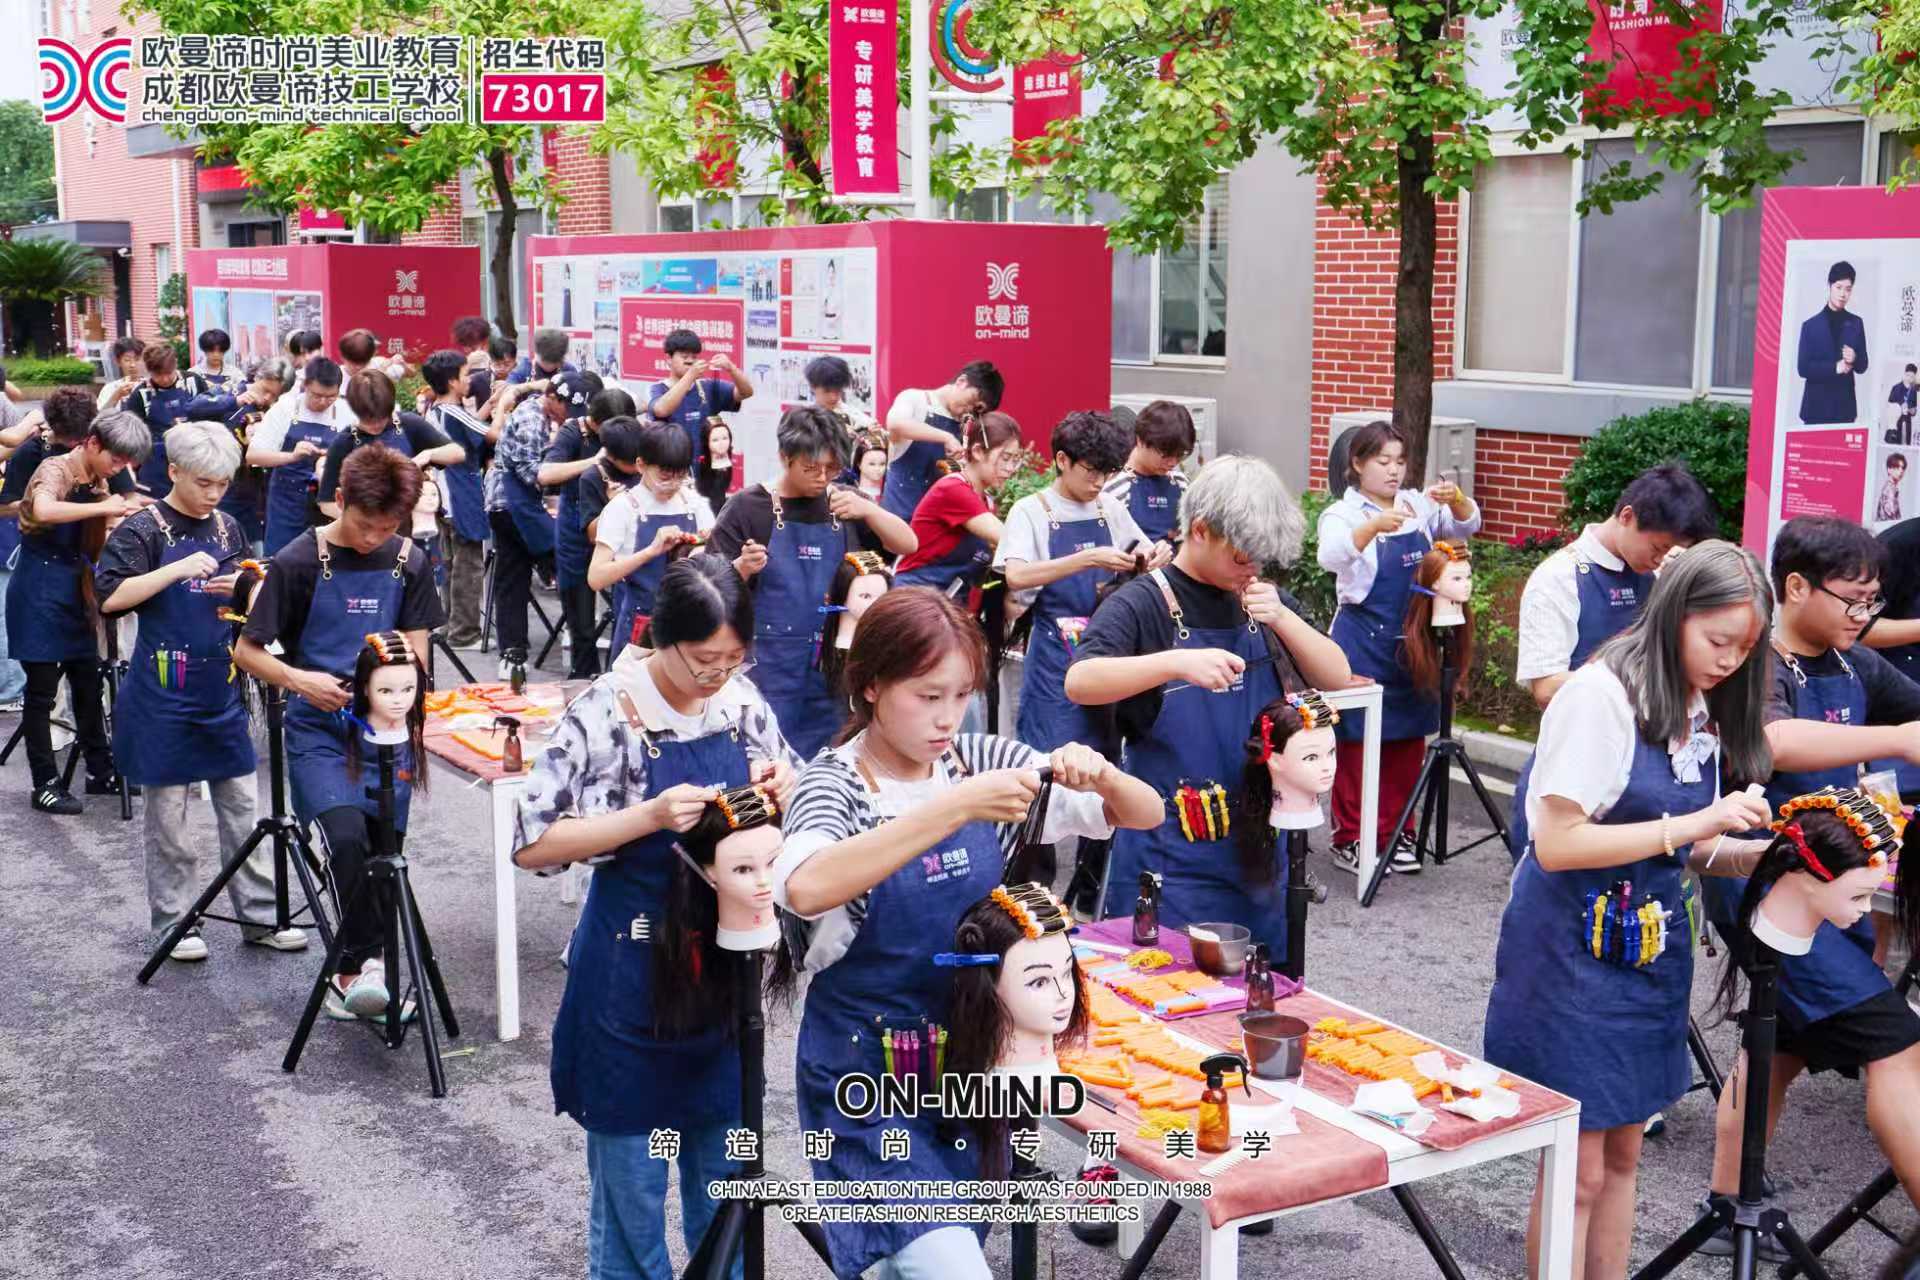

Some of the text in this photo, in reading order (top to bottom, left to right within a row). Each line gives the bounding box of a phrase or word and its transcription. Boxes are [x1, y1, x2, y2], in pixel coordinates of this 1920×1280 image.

[1609, 17, 1652, 31] FASHION
[854, 40, 874, 177] 专研美学教育
[975, 304, 1030, 326] 欧曼谛
[975, 326, 1030, 339] on-mind
